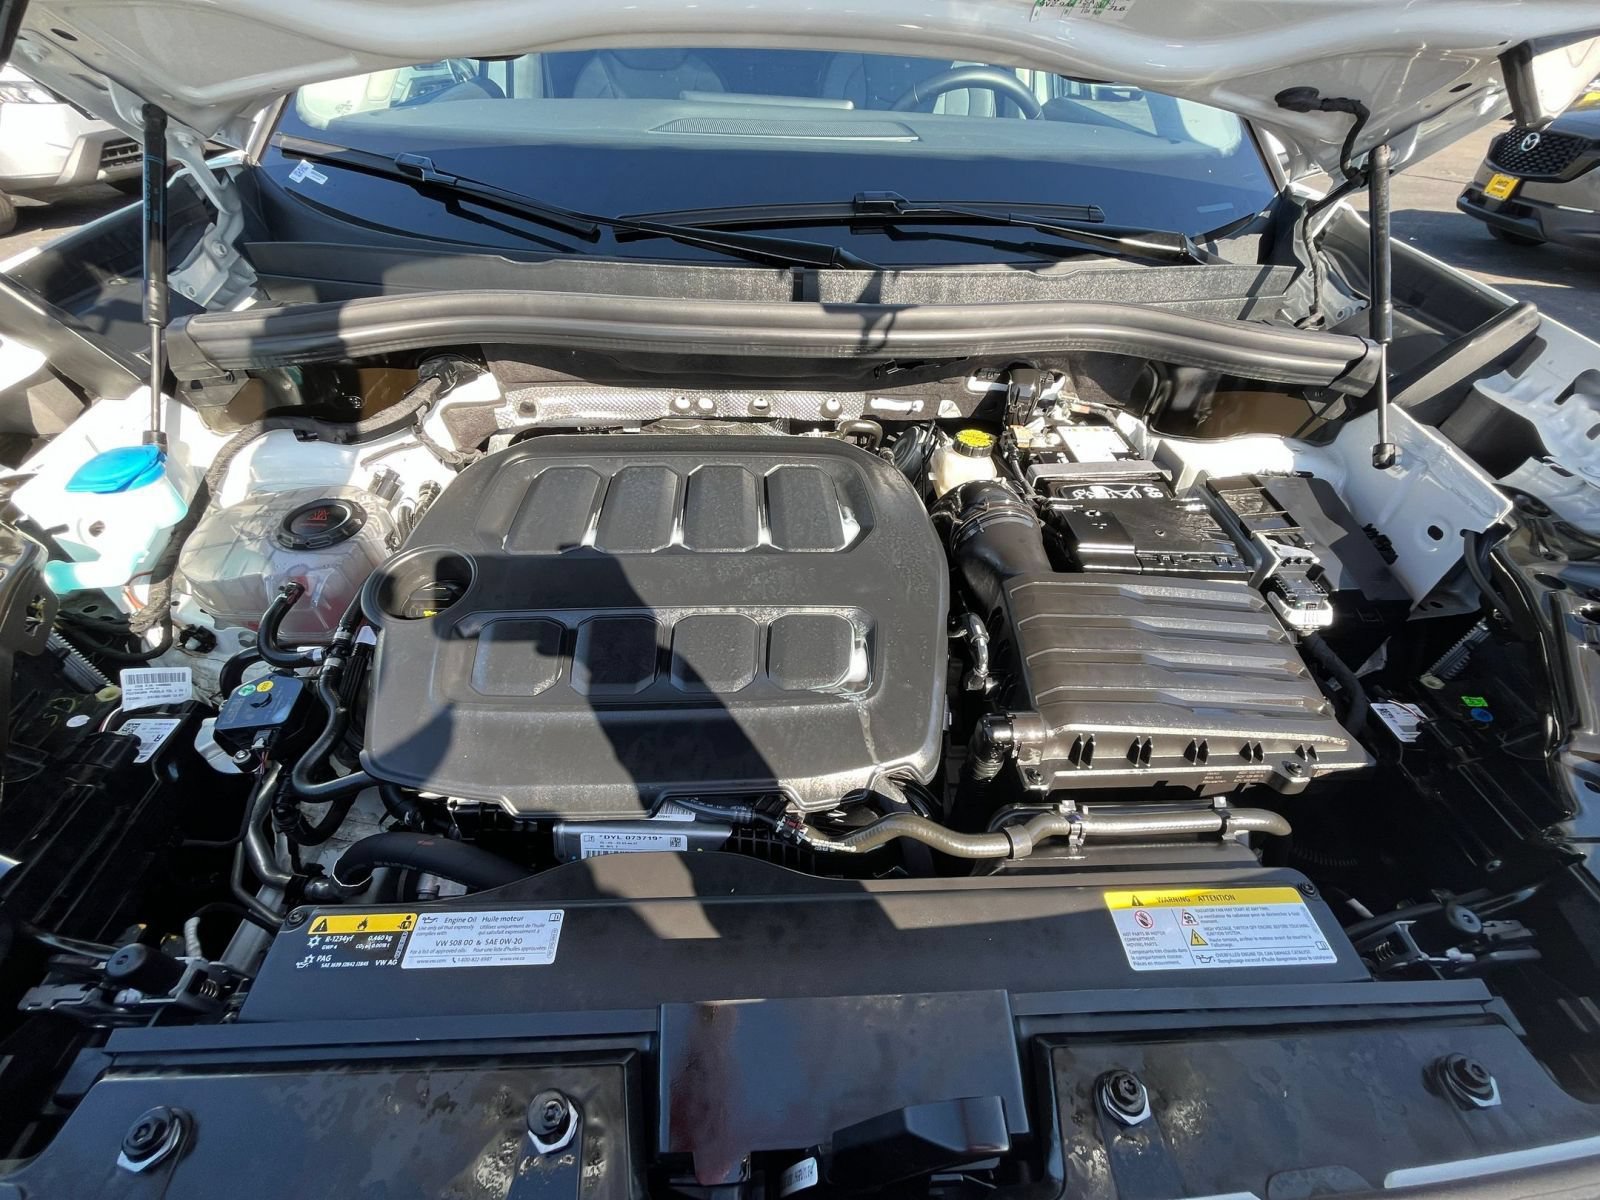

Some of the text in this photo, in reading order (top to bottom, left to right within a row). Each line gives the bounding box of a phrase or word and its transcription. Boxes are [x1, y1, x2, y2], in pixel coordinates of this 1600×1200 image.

[1156, 896, 1191, 904] WARNING
[1197, 894, 1236, 902] ATTENTION
[444, 917, 466, 925] Engine
[325, 935, 355, 943] R-1234yf
[316, 954, 332, 962] PAG
